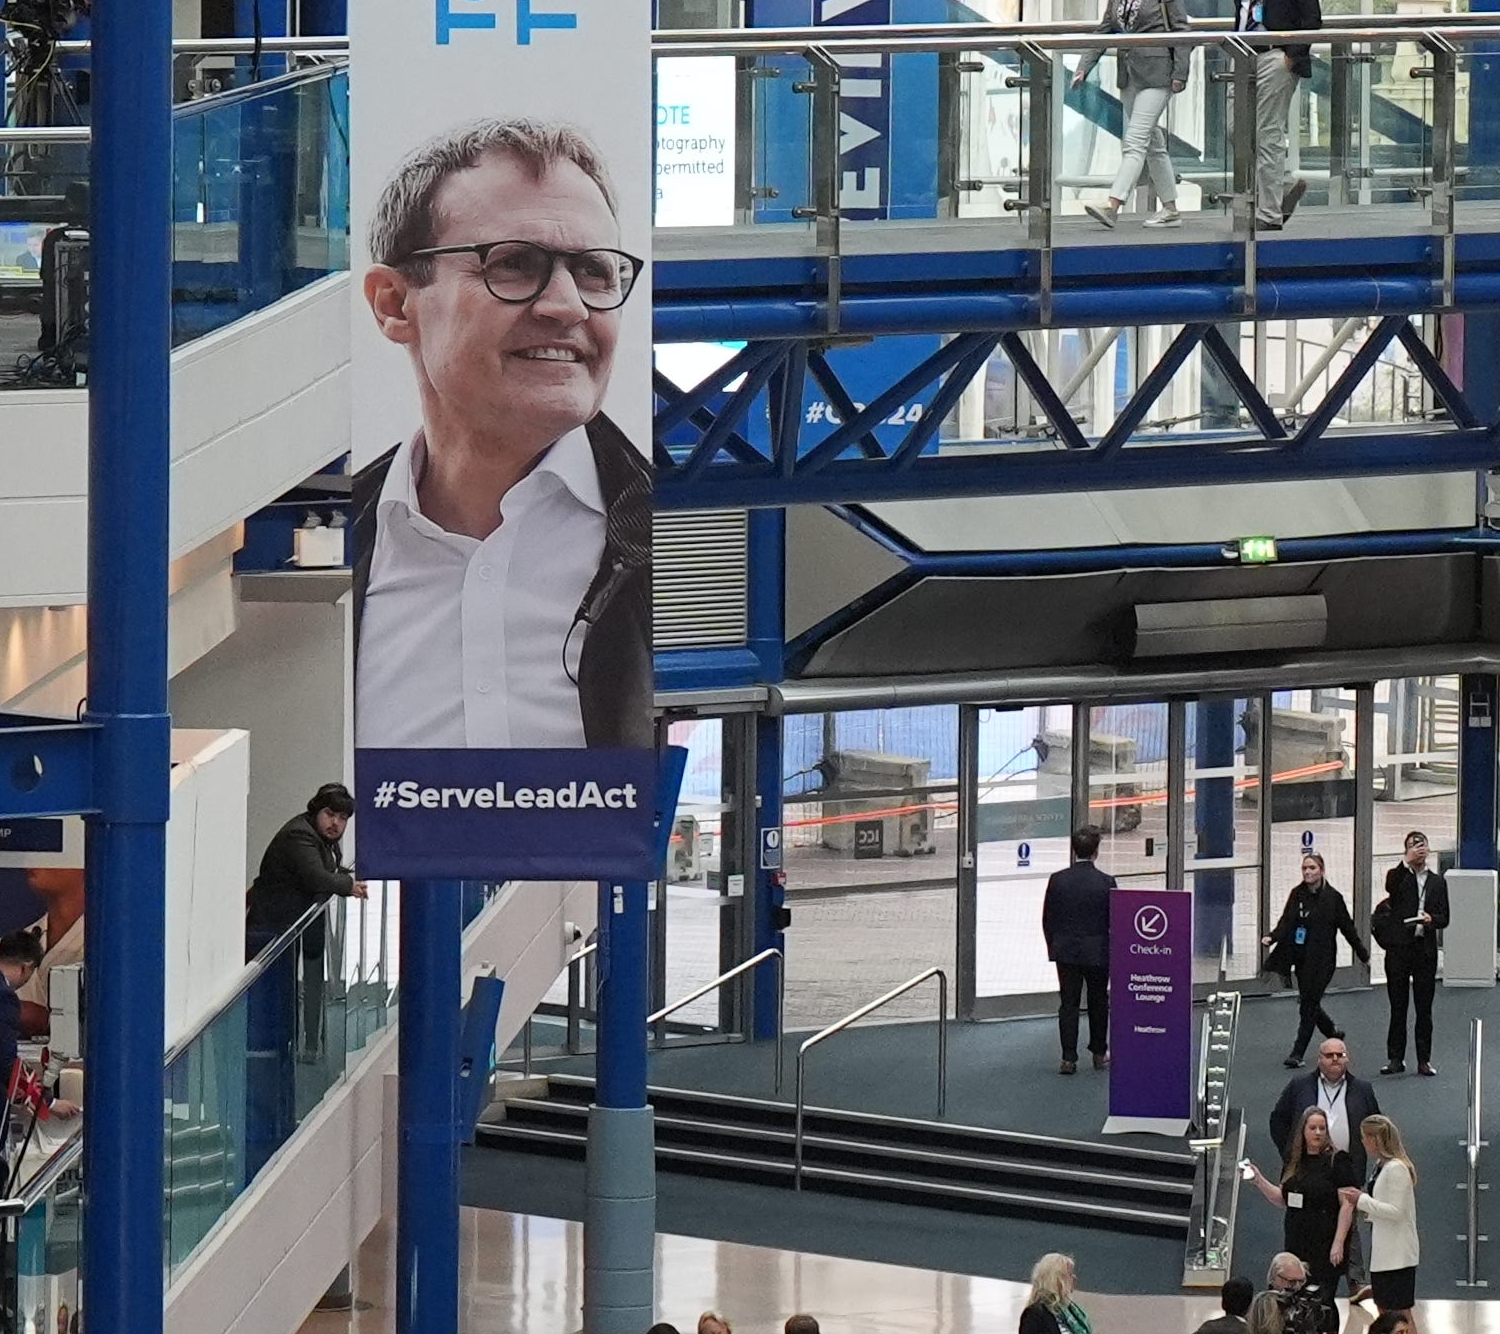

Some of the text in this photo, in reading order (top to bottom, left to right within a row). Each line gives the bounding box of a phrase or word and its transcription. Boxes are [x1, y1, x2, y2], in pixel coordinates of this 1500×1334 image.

[373, 779, 638, 811] #ServeLeadAct
[1129, 943, 1172, 956] Check-in
[1130, 973, 1171, 984] Heathrow
[1128, 983, 1173, 993] Conference
[1135, 993, 1166, 1003] Lounge
